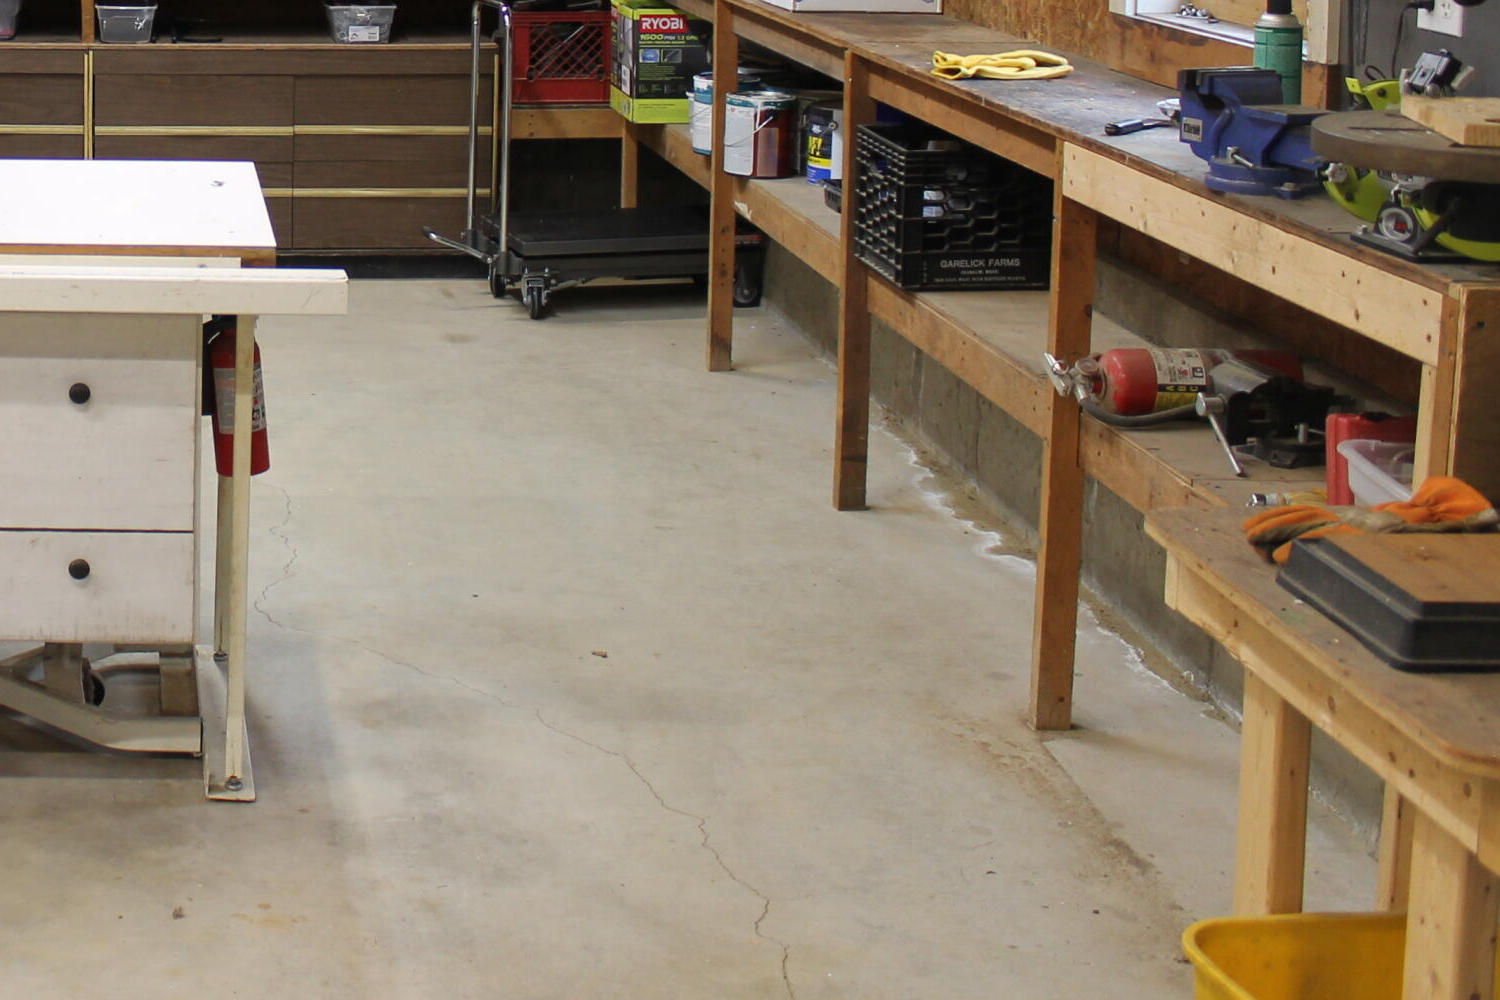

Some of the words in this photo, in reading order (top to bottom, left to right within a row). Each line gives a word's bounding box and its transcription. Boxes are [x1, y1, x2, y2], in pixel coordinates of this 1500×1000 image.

[641, 17, 684, 30] RYOBI
[940, 259, 985, 269] GARELICK
[988, 258, 1021, 267] FARMS
